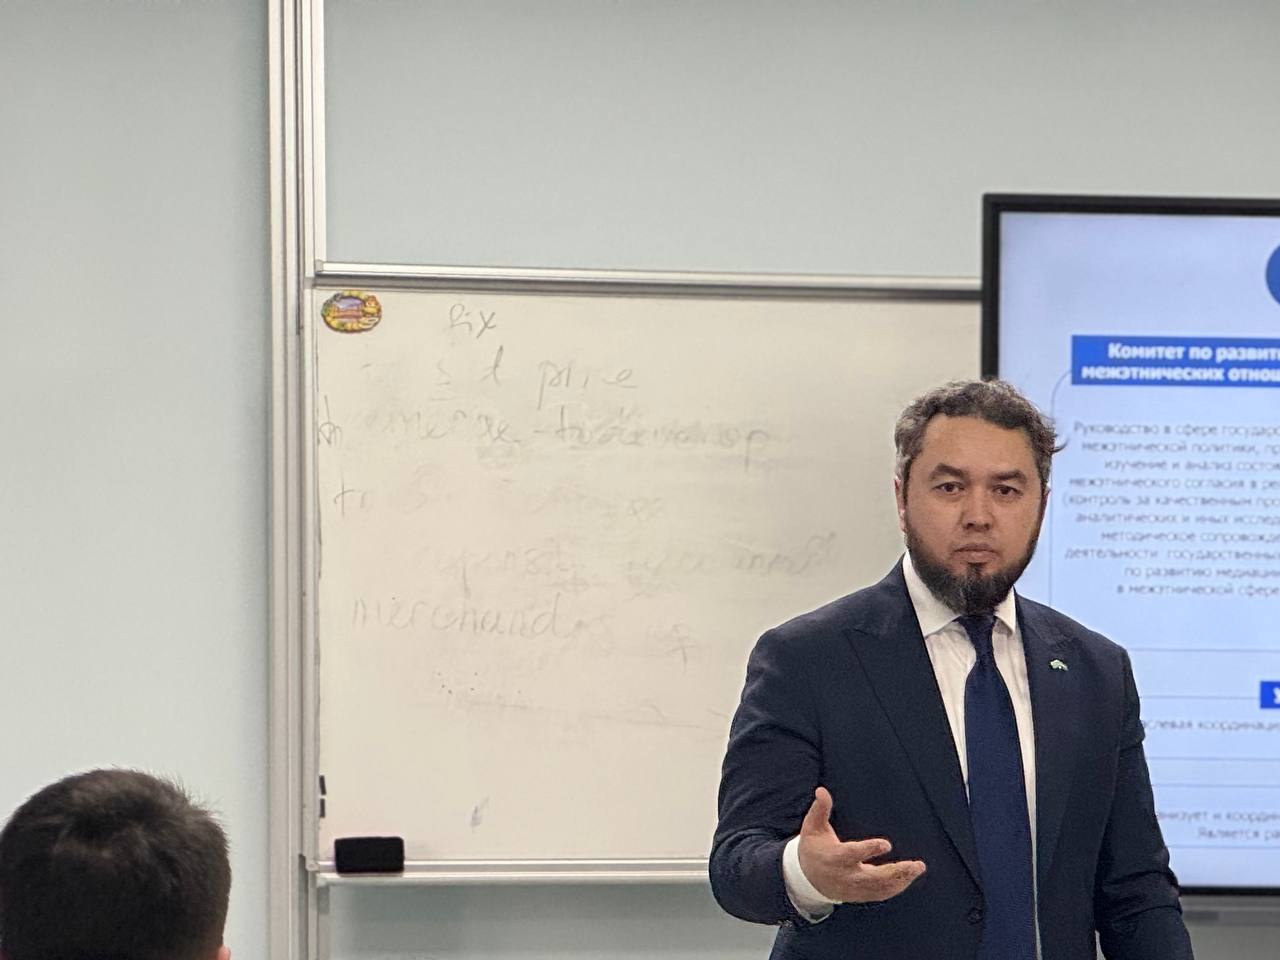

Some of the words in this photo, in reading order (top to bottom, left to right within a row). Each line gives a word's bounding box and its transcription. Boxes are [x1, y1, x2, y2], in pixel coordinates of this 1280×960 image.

[1108, 342, 1185, 359] Комитет
[1189, 346, 1211, 360] по
[1082, 366, 1224, 380] межэтнических
